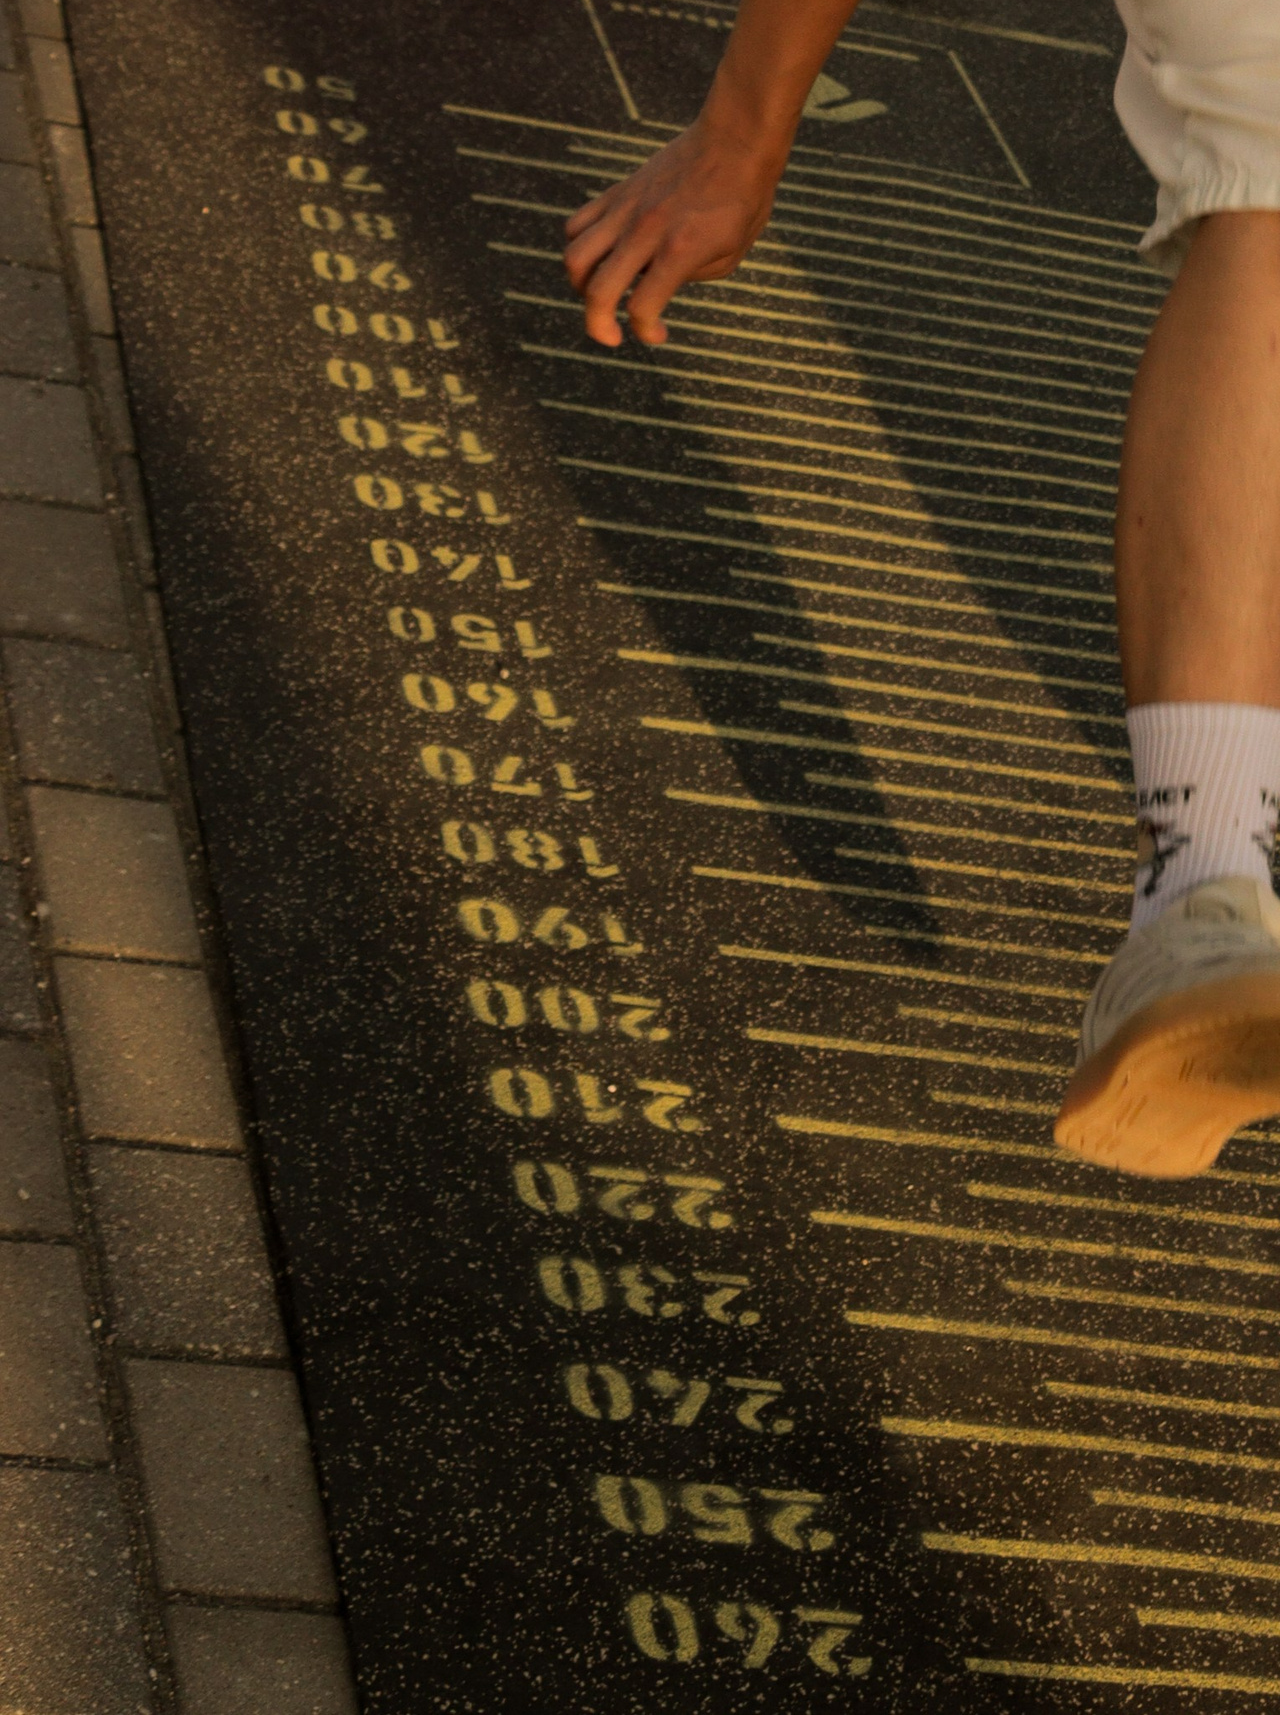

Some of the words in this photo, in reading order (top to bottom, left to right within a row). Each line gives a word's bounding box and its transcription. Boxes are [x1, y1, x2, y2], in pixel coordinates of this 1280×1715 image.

[261, 63, 358, 102] 50
[274, 106, 370, 146] 60
[285, 153, 385, 195] 70
[298, 202, 398, 241] 80
[311, 247, 412, 293] 90
[312, 302, 461, 352] 100
[325, 355, 478, 407] 110
[336, 414, 496, 465] 120
[350, 472, 512, 527] 130
[368, 535, 533, 591] 140
[386, 603, 553, 660] 150
[400, 671, 576, 730] 160
[418, 742, 594, 802] 170
[439, 817, 620, 879] 180
[455, 895, 645, 957] 190
[463, 978, 671, 1043] 200
[486, 1065, 703, 1135] 210
[511, 1158, 734, 1231] 220
[535, 1253, 761, 1328] 230
[561, 1361, 795, 1437] 240
[592, 1473, 837, 1552] 250
[624, 1591, 873, 1677] 260
